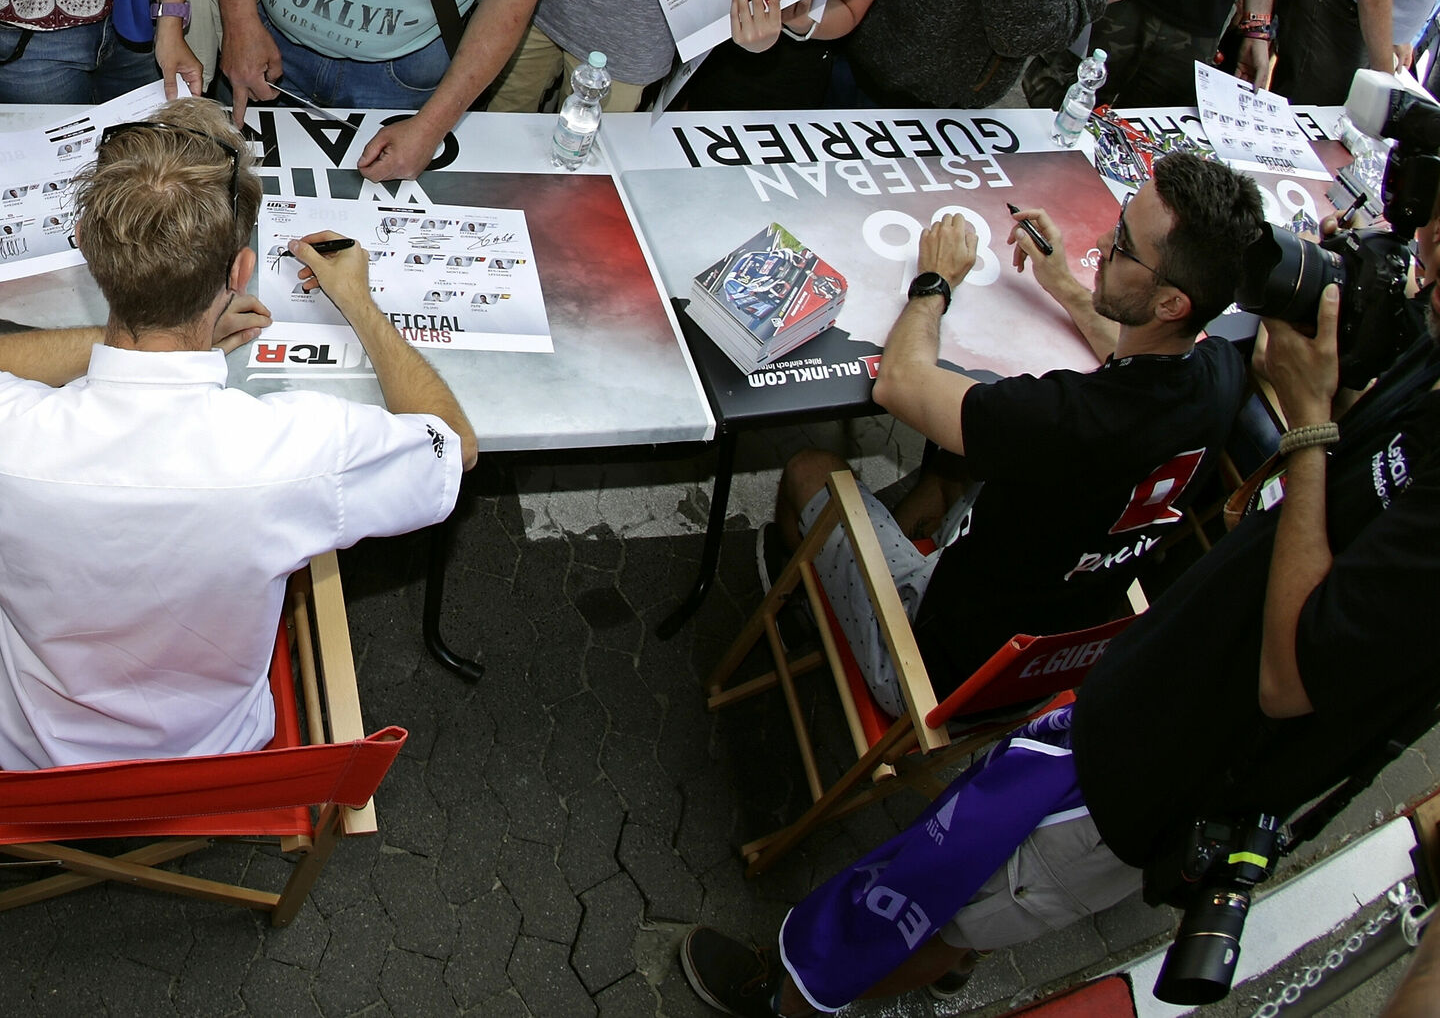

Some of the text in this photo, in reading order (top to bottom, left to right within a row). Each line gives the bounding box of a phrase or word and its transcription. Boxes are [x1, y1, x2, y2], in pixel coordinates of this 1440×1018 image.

[281, 6, 319, 33] YORK
[326, 29, 364, 50] CITY
[671, 116, 1021, 168] GUERRIERI
[742, 153, 1015, 203] ESTEBAN
[400, 327, 452, 343] IVERS
